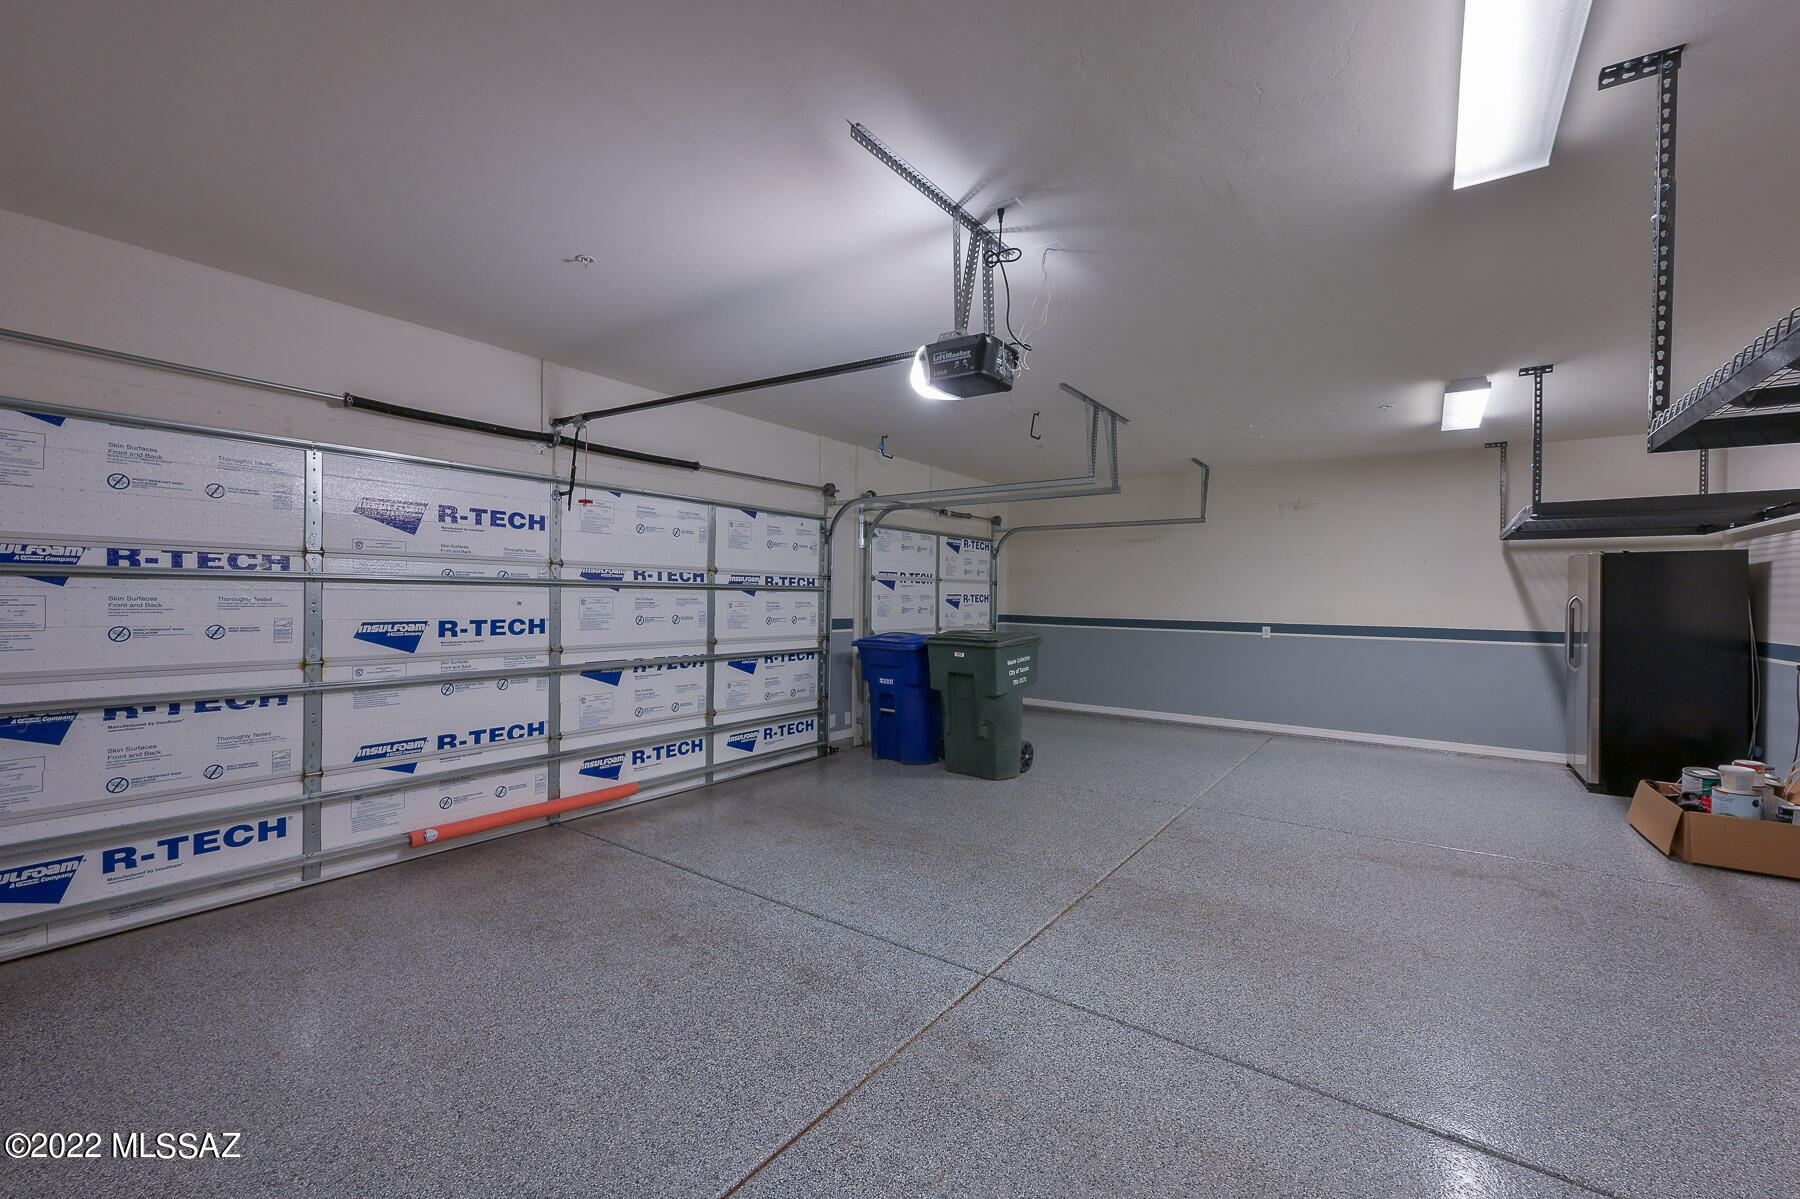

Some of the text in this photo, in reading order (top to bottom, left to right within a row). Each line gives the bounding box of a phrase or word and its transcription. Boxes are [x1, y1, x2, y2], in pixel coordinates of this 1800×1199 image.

[108, 449, 128, 457] Front
[126, 444, 158, 453] Surfaces
[438, 505, 545, 531] R-TECH
[964, 540, 990, 551] R-TECH
[107, 547, 290, 571] R-TECH
[765, 575, 815, 586] R-TECH
[963, 594, 989, 603] R-TECH
[438, 618, 545, 638] R-TECH
[107, 722, 147, 730] Manufactured
[763, 720, 814, 740] R-TECH
[217, 734, 250, 742] Thoroughly
[437, 720, 544, 750] R-TECH
[631, 738, 703, 765] R-TECH
[103, 816, 287, 874] R-TECH
[41, 872, 73, 882] Company
[107, 871, 146, 882] Manufactured
